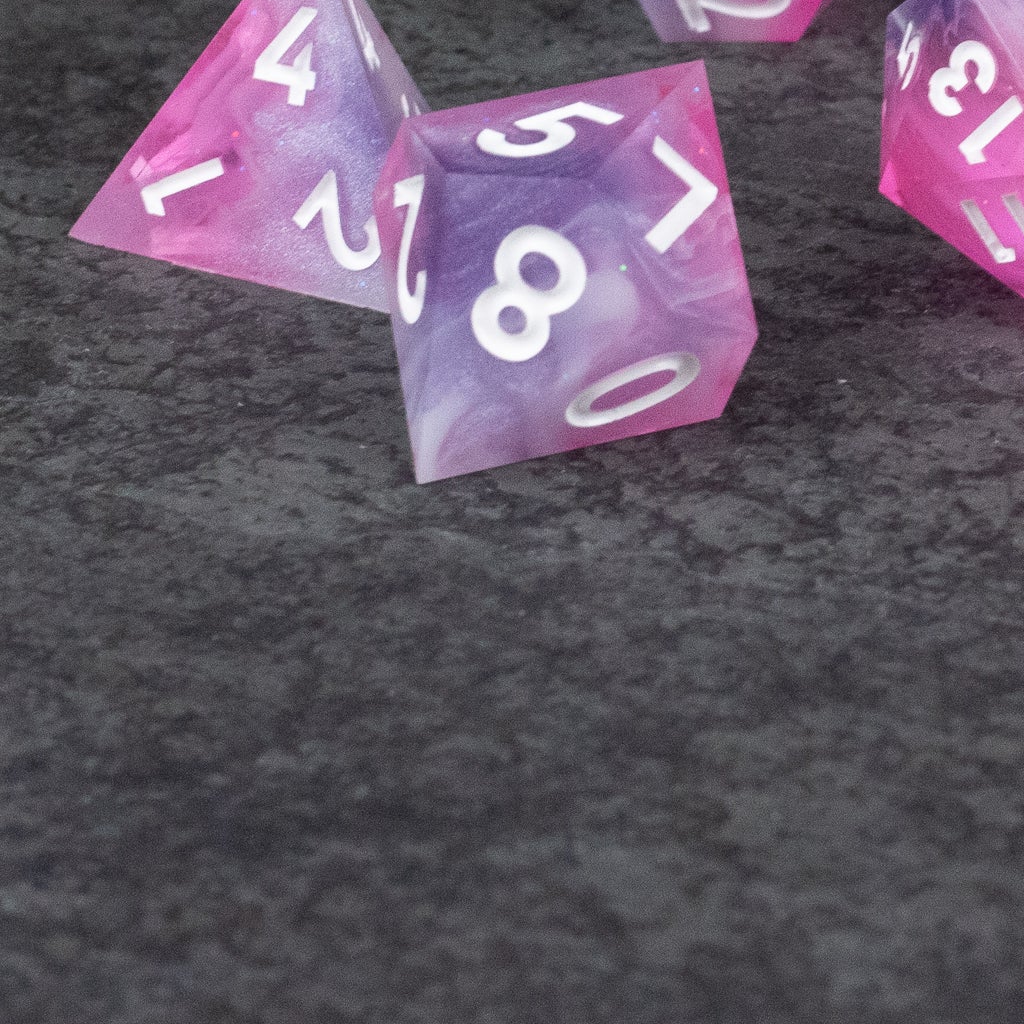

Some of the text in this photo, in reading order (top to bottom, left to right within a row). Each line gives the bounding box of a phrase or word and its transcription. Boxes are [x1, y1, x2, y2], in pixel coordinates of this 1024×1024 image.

[253, 6, 318, 106] 4
[928, 40, 1024, 165] 13
[476, 101, 625, 158] 5
[141, 157, 225, 216] 1
[293, 169, 382, 270] 2
[645, 135, 719, 255] 7
[471, 225, 588, 363] 8
[565, 352, 701, 429] 0
